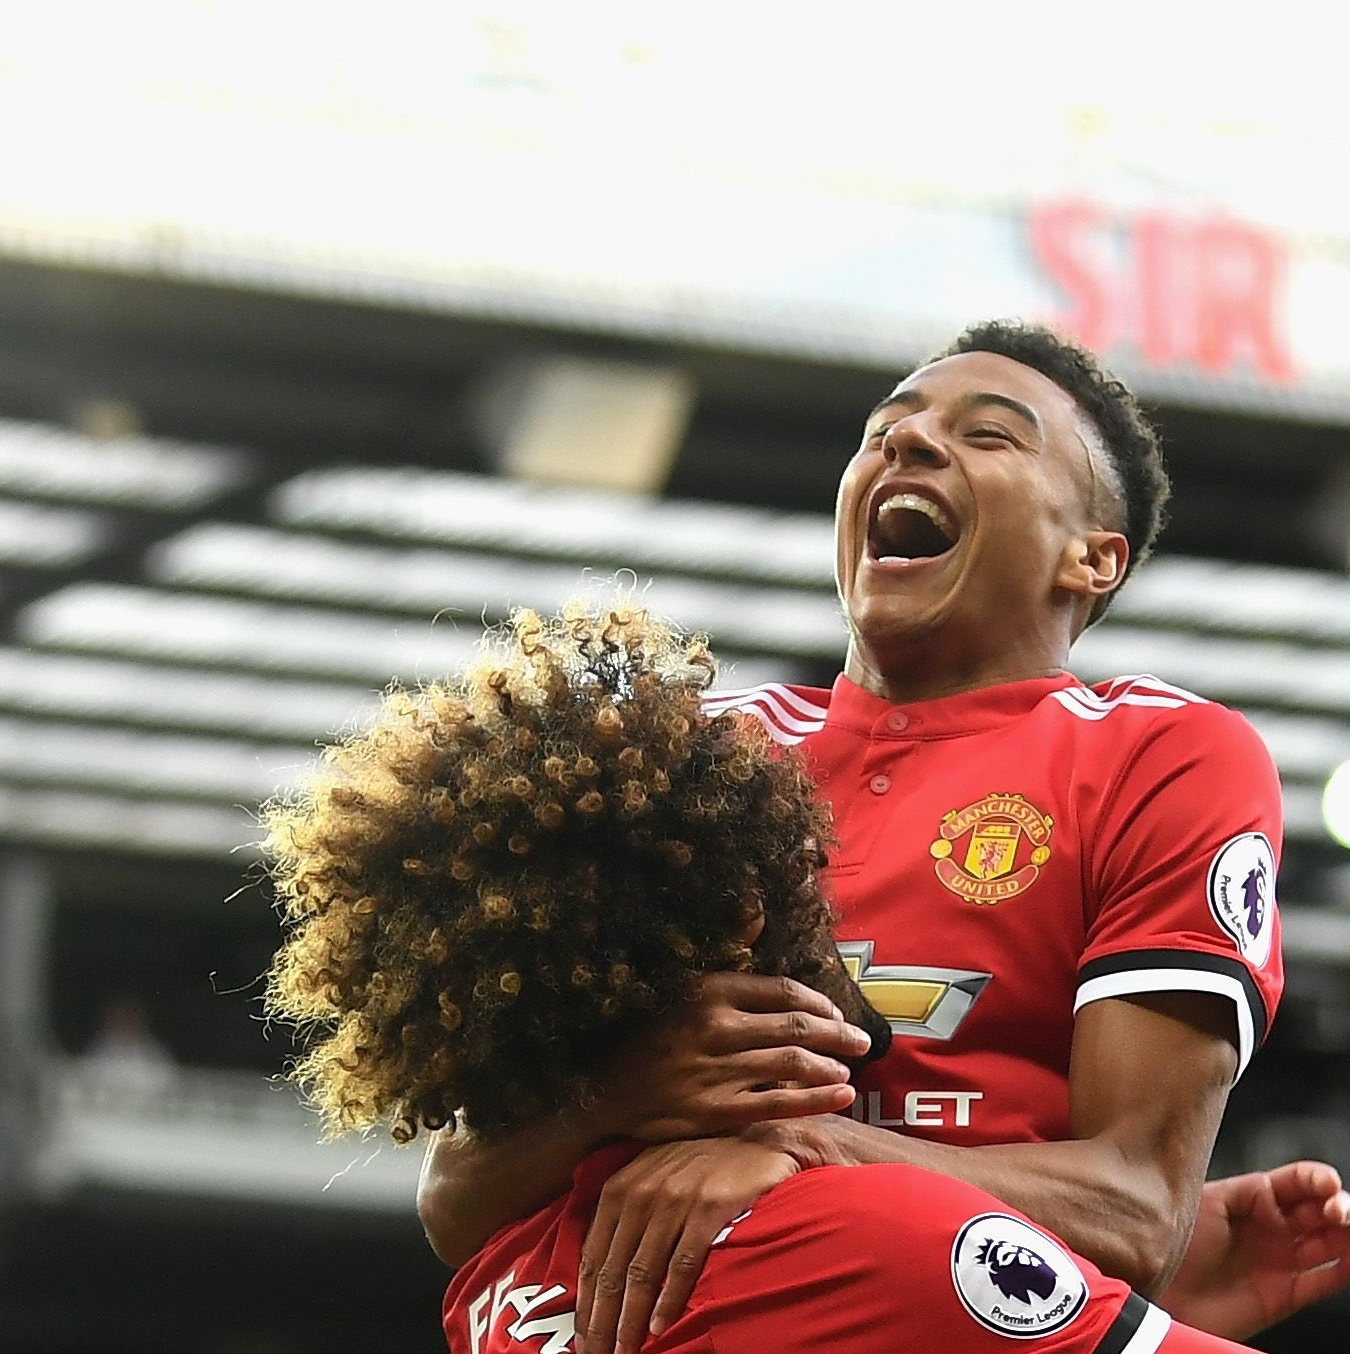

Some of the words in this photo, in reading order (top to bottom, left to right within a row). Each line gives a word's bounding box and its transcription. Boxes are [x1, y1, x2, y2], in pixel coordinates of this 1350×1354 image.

[1026, 200, 1298, 386] SIR
[950, 801, 1045, 840] MANCHESTER
[951, 874, 1019, 896] UNITED
[991, 1305, 1035, 1325] Premier
[1036, 1294, 1072, 1323] League
